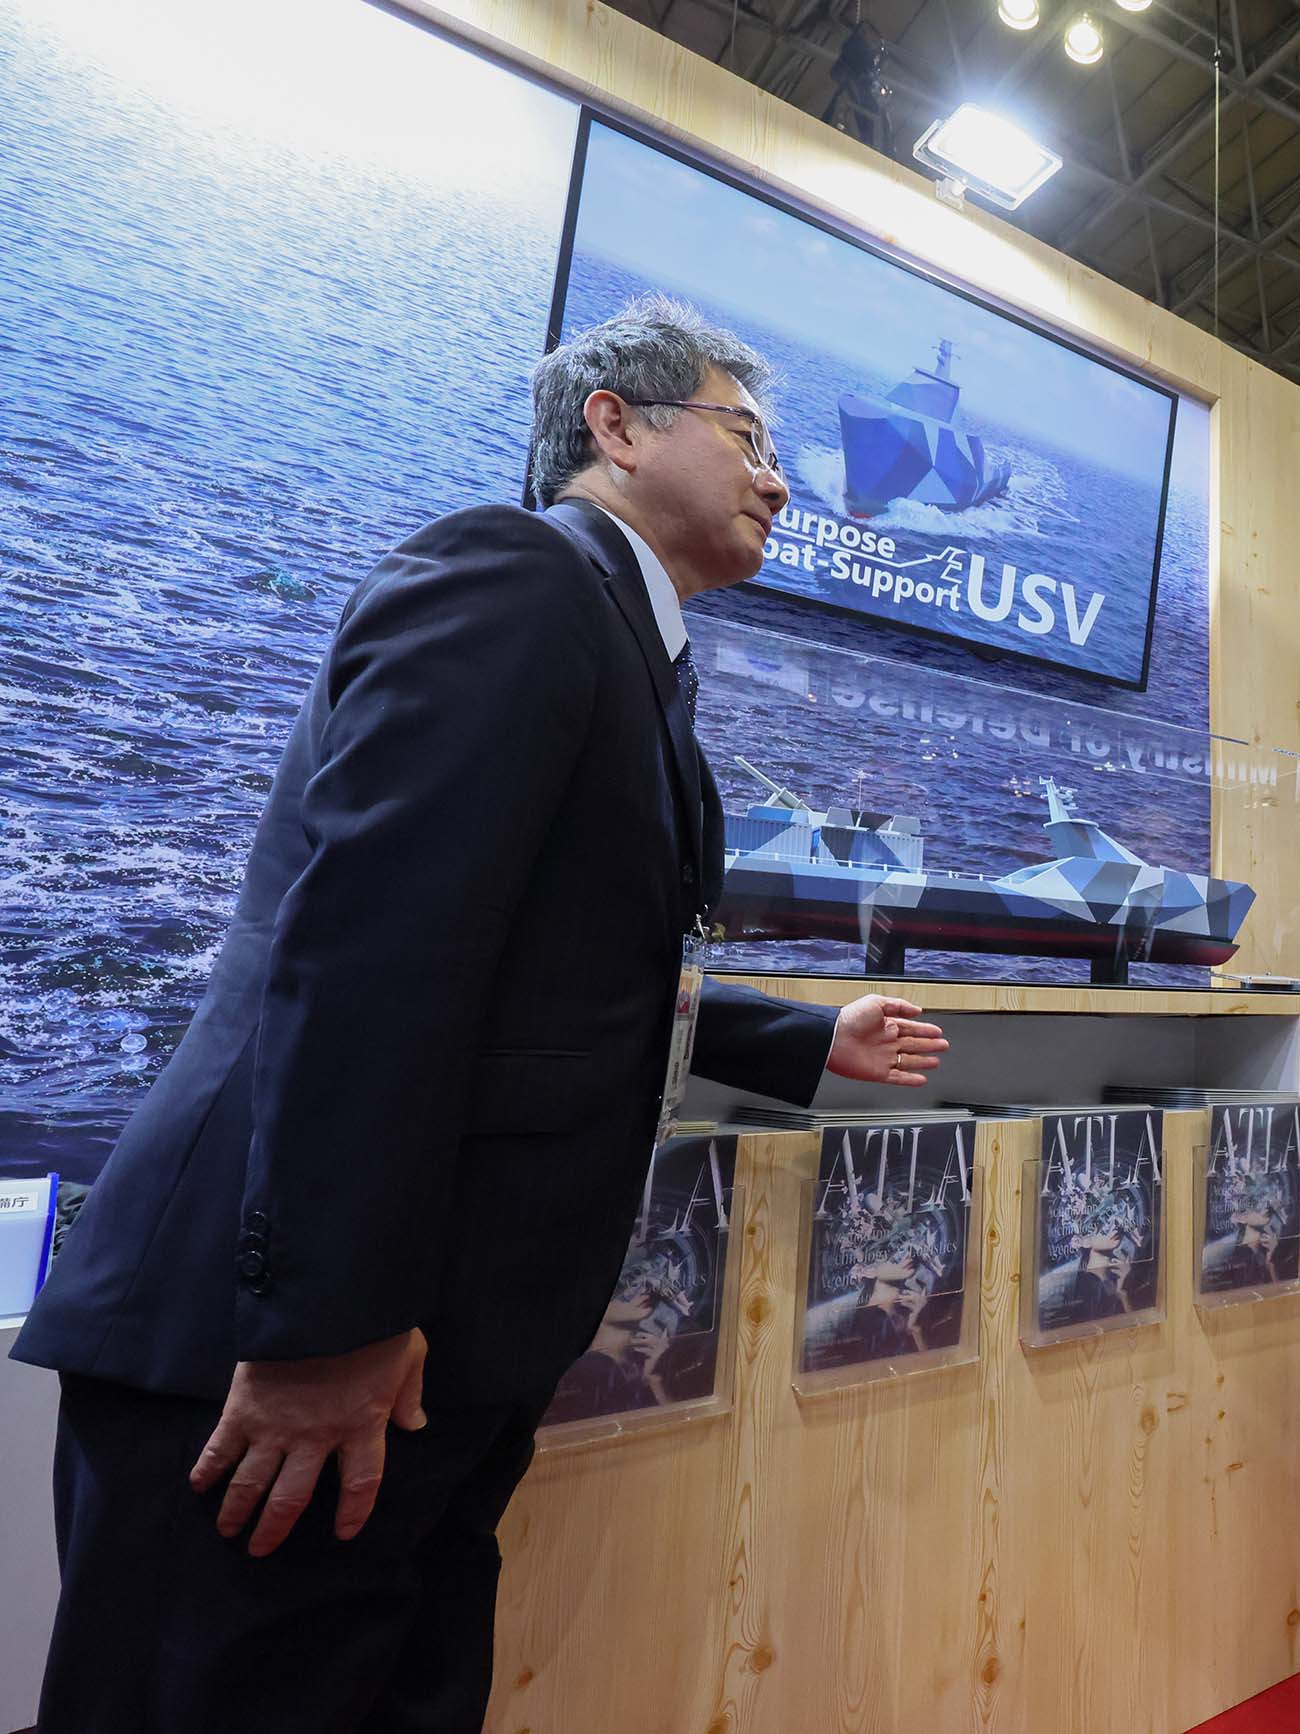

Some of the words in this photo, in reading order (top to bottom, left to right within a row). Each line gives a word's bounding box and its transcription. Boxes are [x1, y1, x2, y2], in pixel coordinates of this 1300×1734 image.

[779, 504, 896, 558] urpose
[967, 553, 1105, 647] USV
[813, 1123, 972, 1221] ATLA
[1040, 1112, 1162, 1197] ATLA
